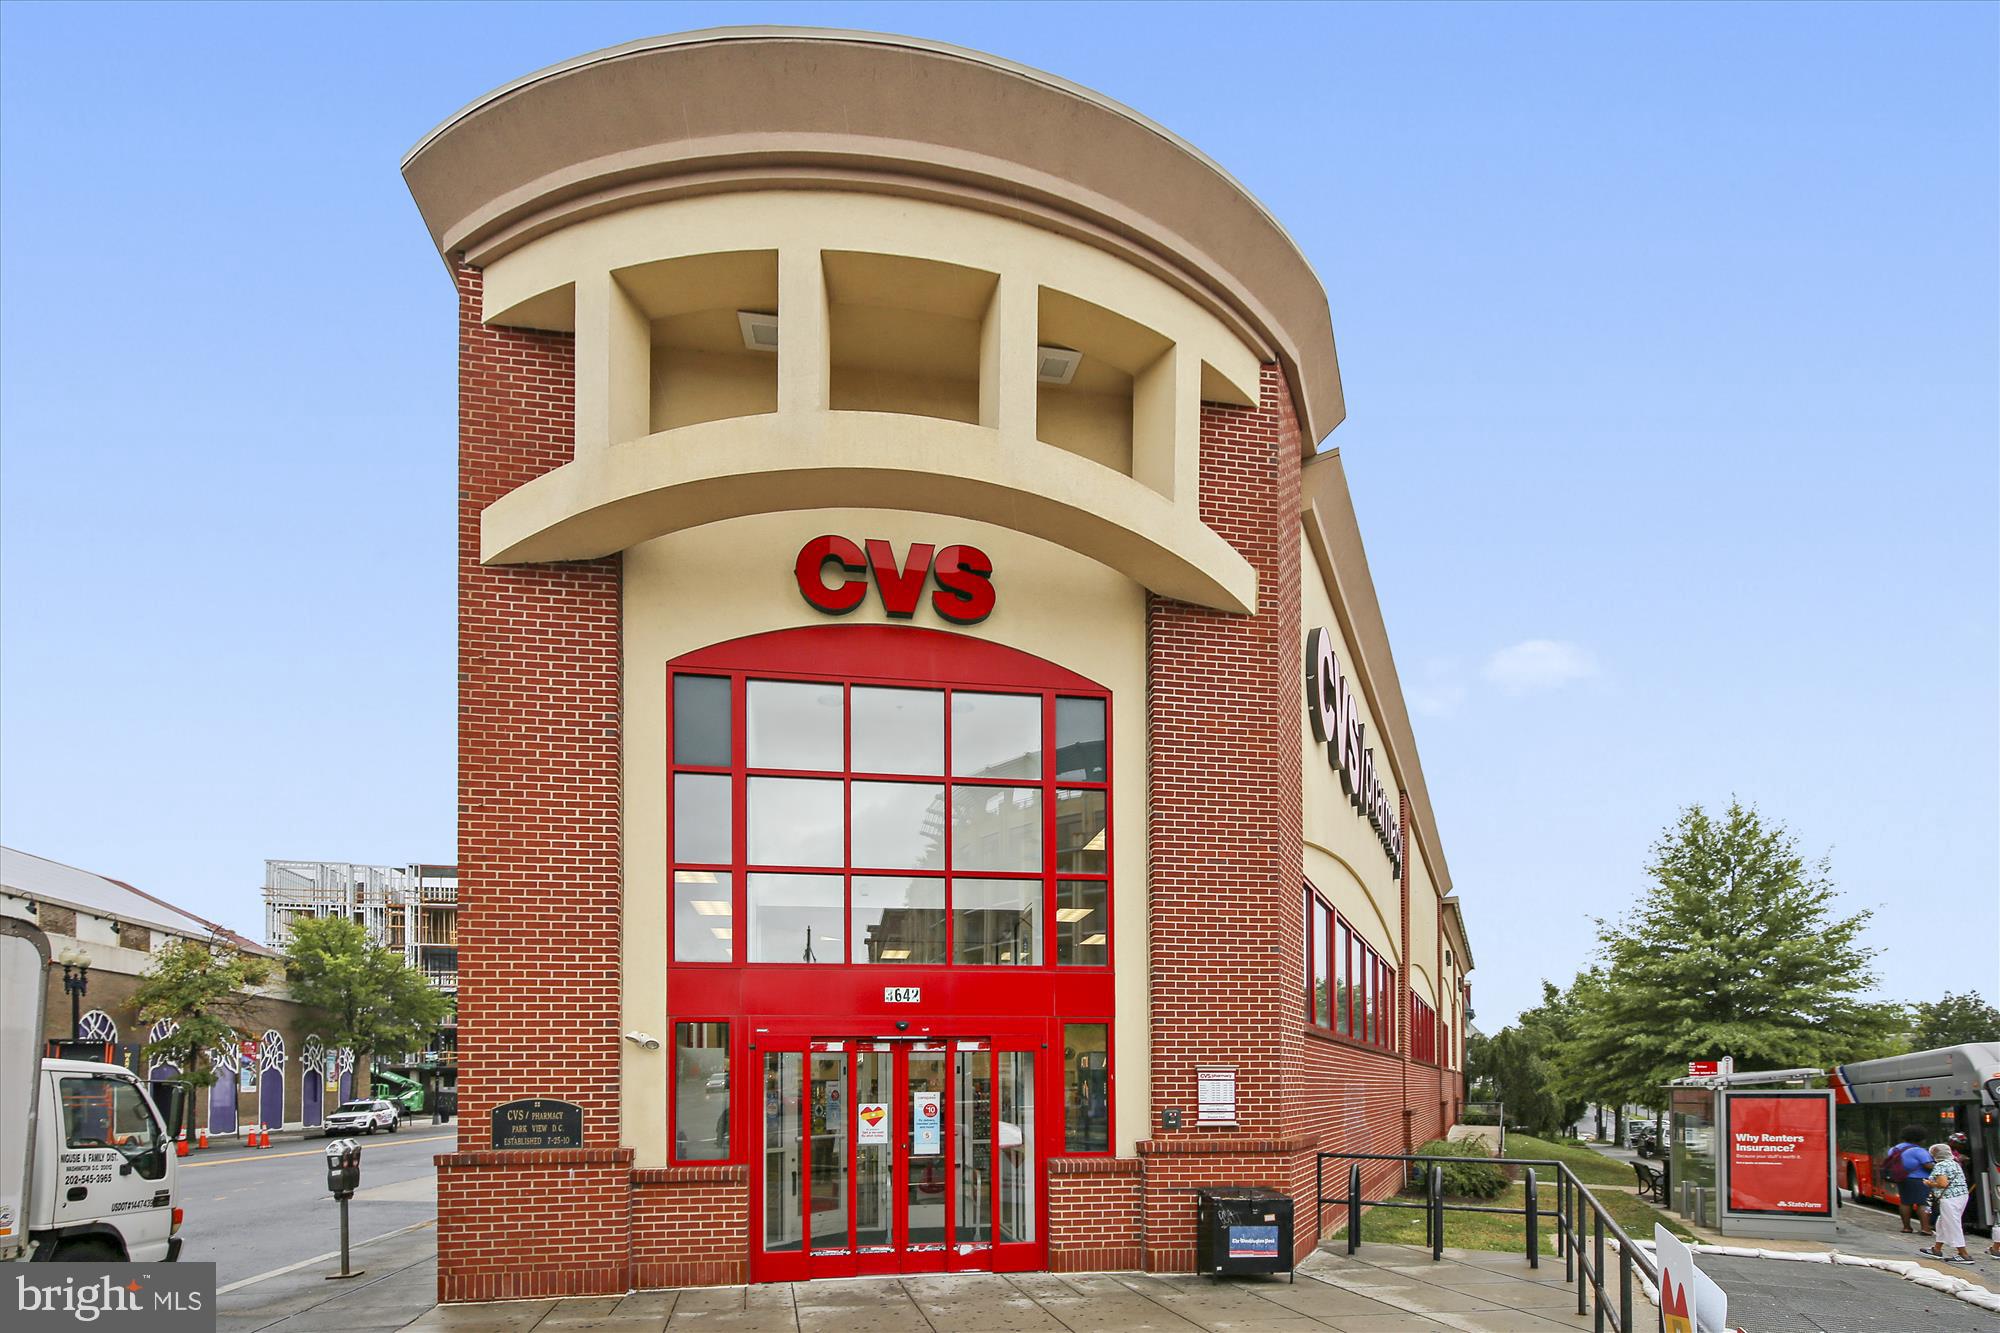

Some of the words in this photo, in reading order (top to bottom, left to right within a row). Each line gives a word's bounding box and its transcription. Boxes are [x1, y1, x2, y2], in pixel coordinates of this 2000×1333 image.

[794, 535, 997, 625] CVS
[531, 1112, 564, 1120] PHARMACY
[512, 1125, 528, 1133] PARK
[531, 1124, 548, 1132] VIEW
[504, 1136, 542, 1146] ESTABLISHED
[1735, 1133, 1759, 1143] Why
[1761, 1133, 1804, 1142] Renters
[1736, 1143, 1796, 1152] Insurance?
[88, 1153, 105, 1162] FAMILY
